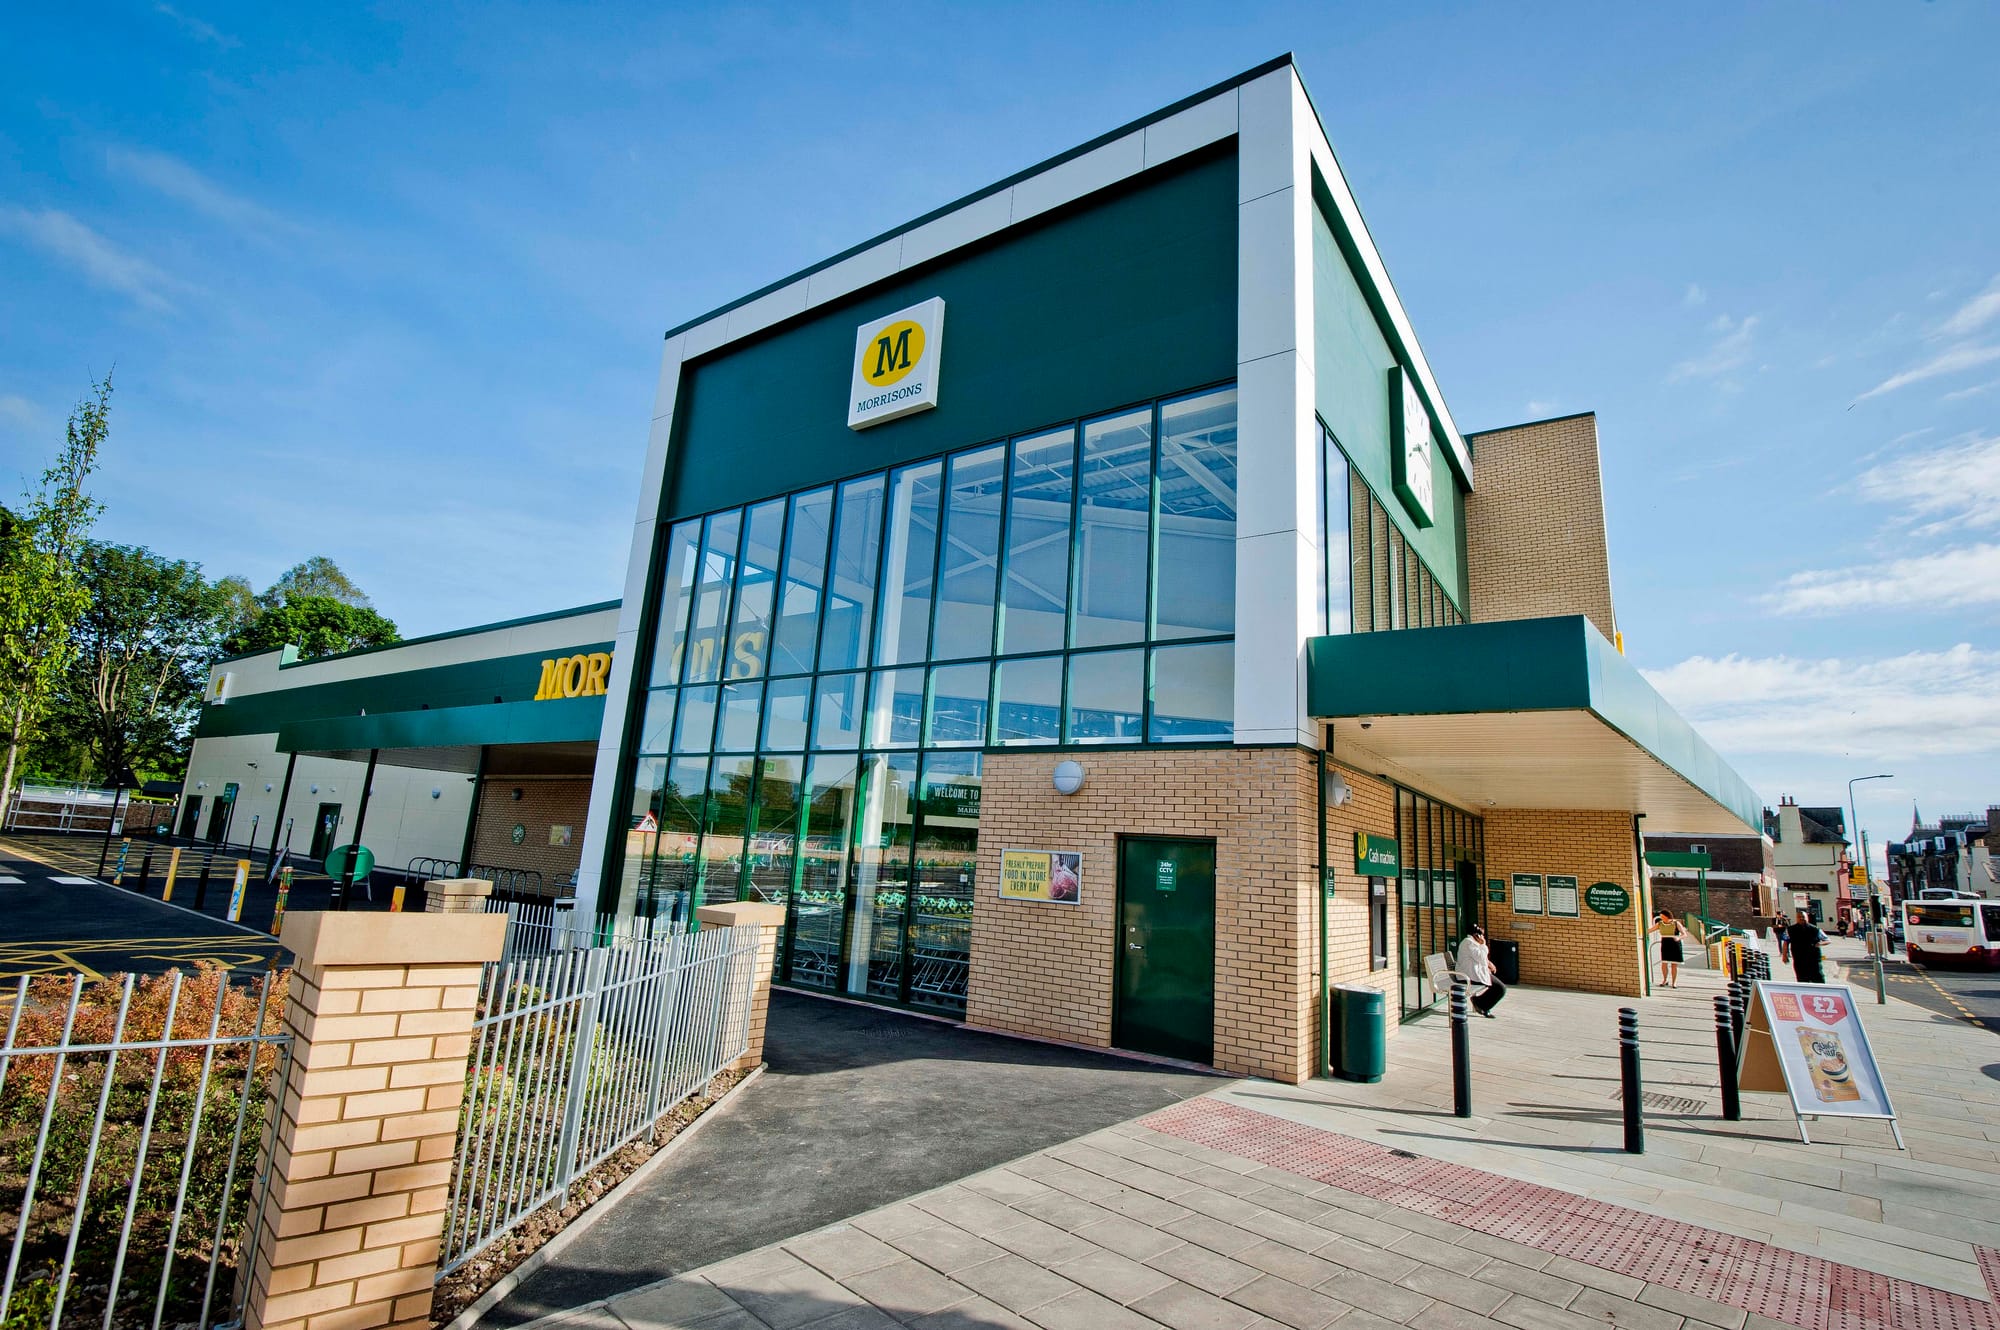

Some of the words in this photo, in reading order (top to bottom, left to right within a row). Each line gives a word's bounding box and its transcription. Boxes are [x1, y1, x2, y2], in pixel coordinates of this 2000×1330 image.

[872, 328, 913, 378] M
[856, 383, 922, 413] MORRISONS
[934, 787, 968, 800] WELCOME
[970, 789, 979, 800] TO
[1368, 848, 1378, 863] Cash
[1379, 850, 1396, 865] machine
[1005, 860, 1025, 869] FRESHLY
[1004, 869, 1018, 880] FOOD
[1020, 870, 1027, 880] IN
[1029, 871, 1047, 882] STORE
[1010, 881, 1026, 891] EVERY
[1029, 882, 1040, 892] DAY
[1590, 887, 1624, 896] Remember
[1813, 996, 1838, 1014] £2
